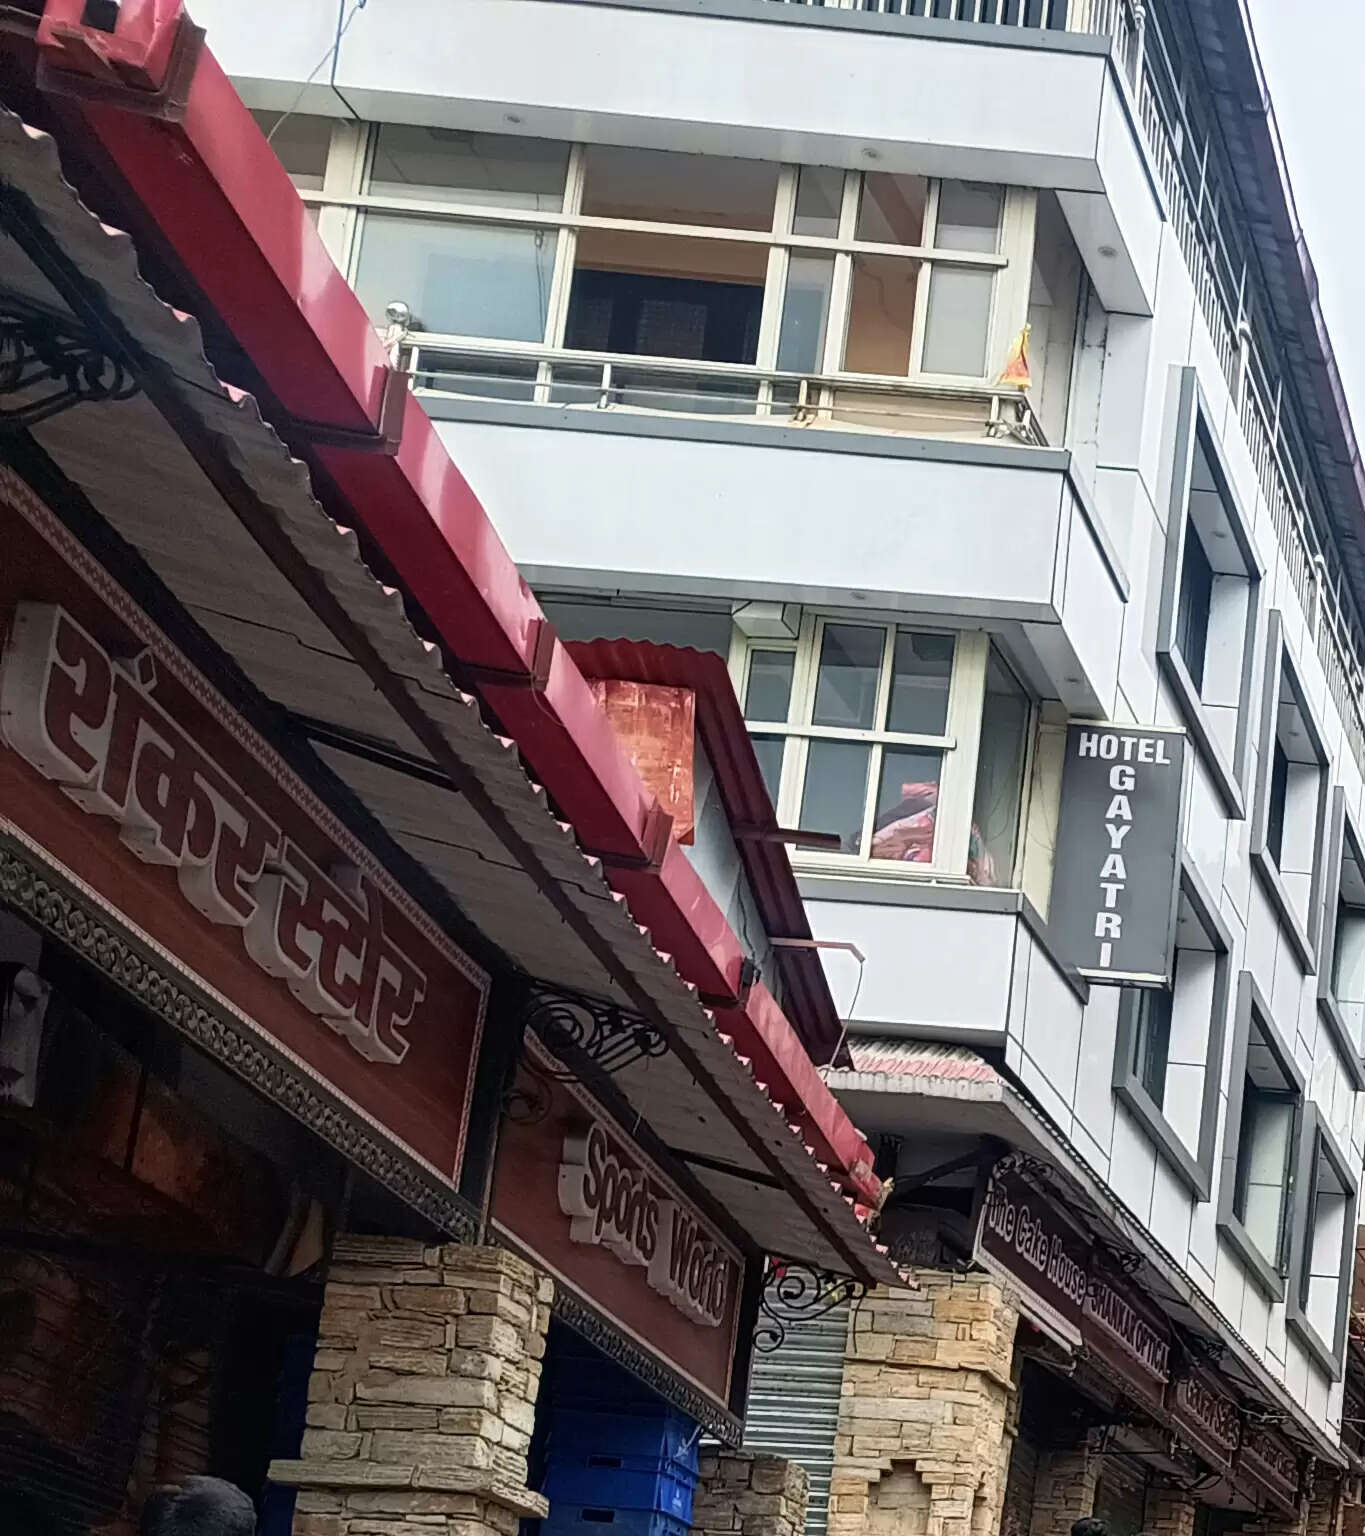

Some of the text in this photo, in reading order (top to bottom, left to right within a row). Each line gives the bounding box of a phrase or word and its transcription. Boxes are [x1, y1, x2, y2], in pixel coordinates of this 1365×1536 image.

[38, 603, 428, 1065] शंकर स्टोर
[1078, 732, 1171, 765] HOTEL
[1095, 764, 1136, 968] GAYATRI
[583, 1120, 729, 1327] Sports World
[1015, 1205, 1049, 1272] Cake
[1047, 1233, 1087, 1306] House
